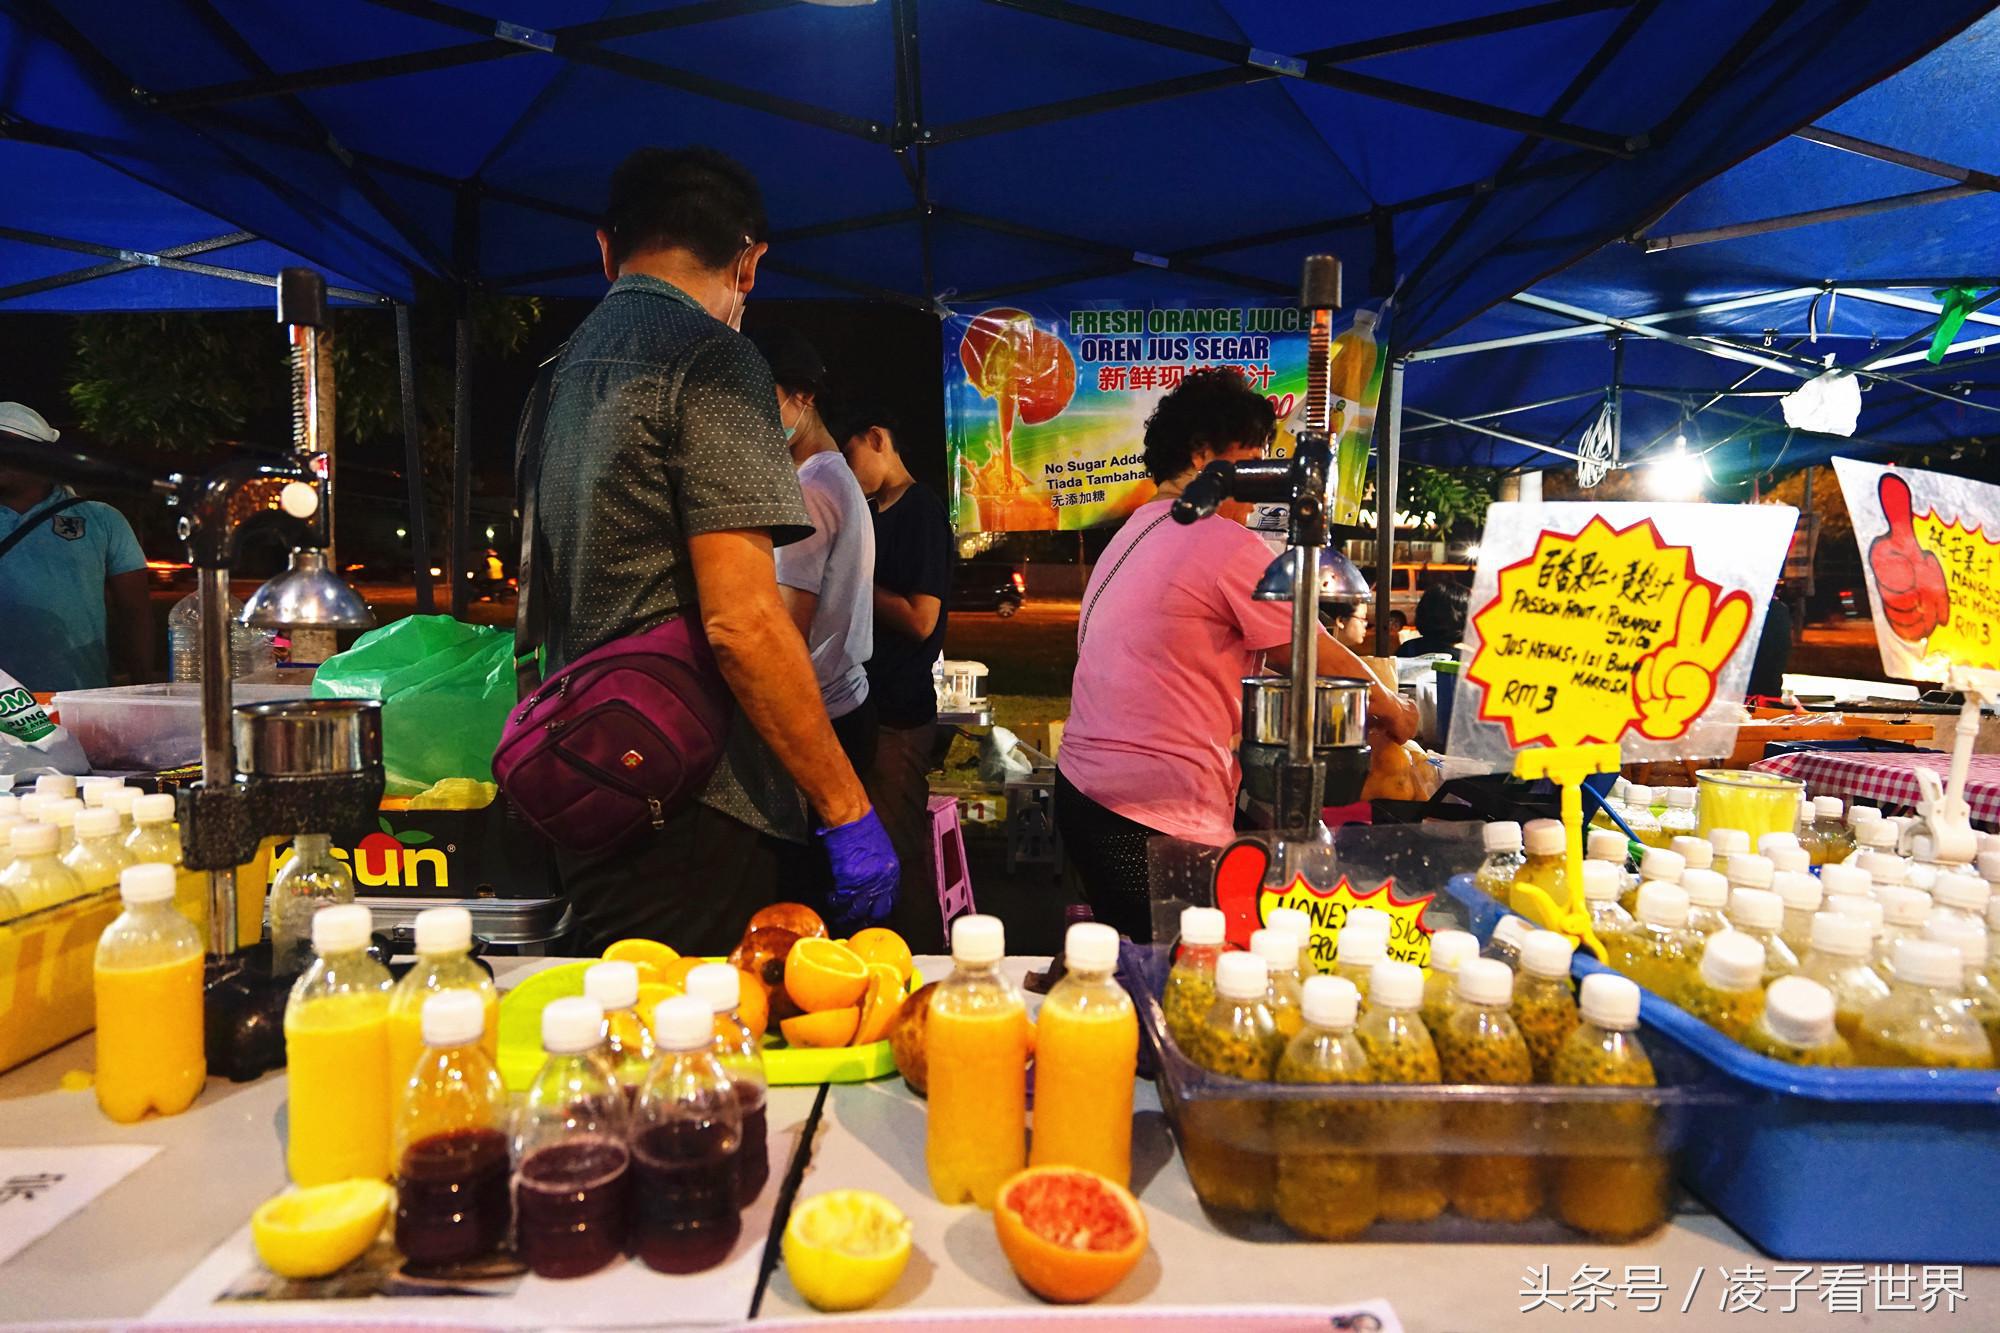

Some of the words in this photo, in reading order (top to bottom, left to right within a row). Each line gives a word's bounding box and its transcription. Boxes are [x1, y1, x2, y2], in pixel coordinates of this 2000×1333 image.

[1070, 311, 1143, 334] FRESH
[1149, 309, 1242, 333] ORANGE
[1246, 308, 1311, 332] JUICE
[1081, 338, 1142, 362] OREN
[1147, 338, 1188, 361] JUS
[1194, 337, 1270, 361] SEGAR
[1044, 463, 1064, 475] No
[1068, 458, 1107, 474] Sugar
[1110, 454, 1145, 468] Adde
[1047, 476, 1083, 490] Tiada
[1052, 490, 1105, 507] 无添加糖
[1955, 615, 1978, 638] RM
[1980, 622, 1991, 645] 3
[1502, 680, 1538, 709] RM
[1536, 686, 1558, 714] 3
